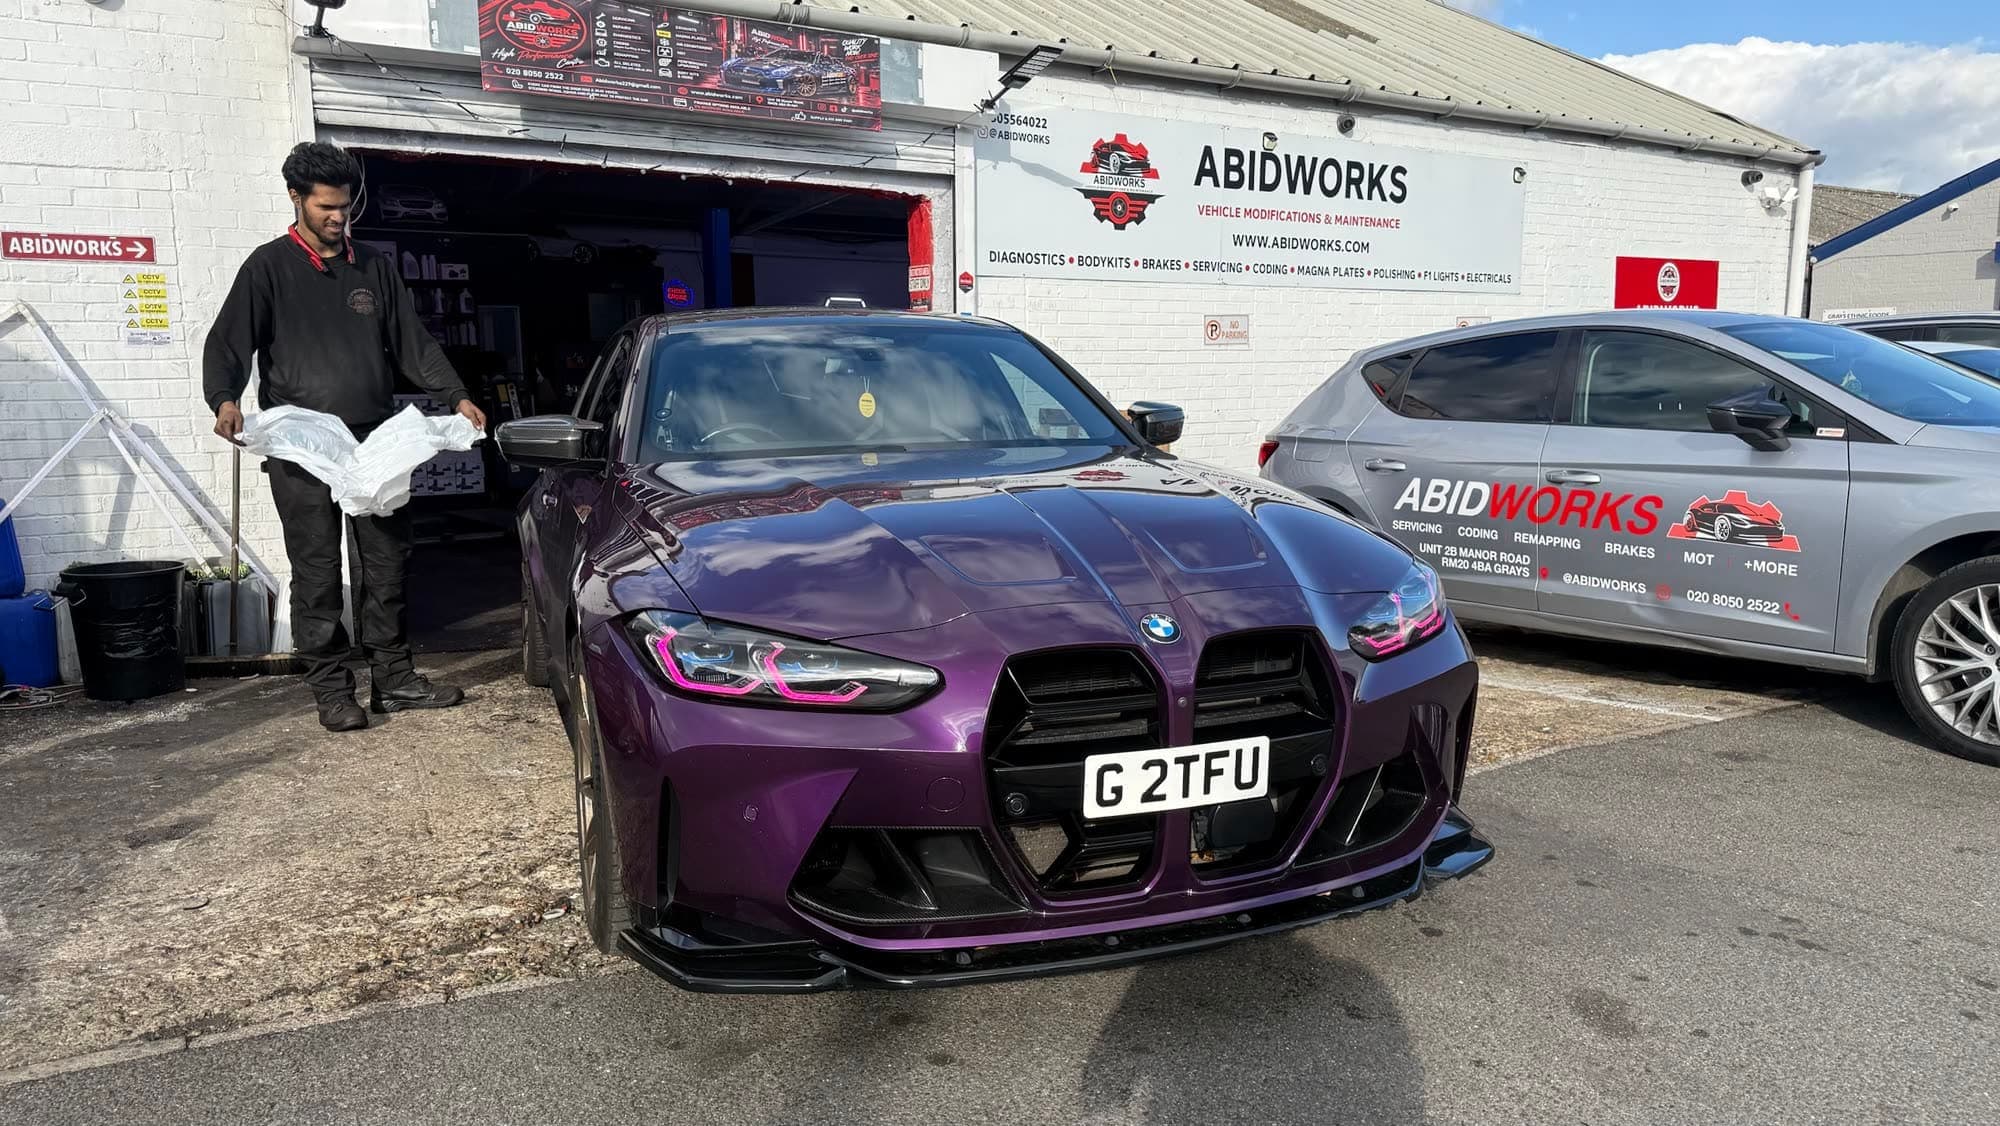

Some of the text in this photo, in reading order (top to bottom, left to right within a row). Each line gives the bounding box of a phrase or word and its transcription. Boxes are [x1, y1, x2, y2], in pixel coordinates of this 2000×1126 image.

[506, 21, 578, 36] ABIDWORKS
[506, 67, 520, 75] 020
[523, 70, 542, 78] 8050
[989, 128, 1050, 144] @ABIDWORKS
[1093, 175, 1146, 188] ABIDWORKS
[1193, 145, 1409, 204] ABIDWORKS
[1198, 204, 1401, 229] VEHICLE MODIFICATIONS & MAINTENANCE
[9, 237, 122, 256] ABIDWORKS
[1232, 234, 1370, 254] WWW.ABIDWORKS.COM
[989, 250, 1512, 284] DIAGNOSTICS BODYKITS BRAKES SERVICING CODING MAGNA PLATES POLISHING F1 LIGHTS ELECTRICALS
[1222, 330, 1248, 339] PARKING
[1230, 320, 1239, 329] NO
[1394, 477, 1663, 535] ABIDWORKS
[1392, 520, 1798, 576] SERVICING CODING REMAPPING BRAKES MOT +MORE
[1419, 543, 1530, 565] UNIT 2B MANOR ROAD
[1442, 557, 1530, 577] RM20 4BA GRAYS
[1563, 572, 1646, 594] @ABIDWORKS
[1686, 590, 1780, 614] 020 8050 2522
[1095, 746, 1260, 808] G 2TFU
